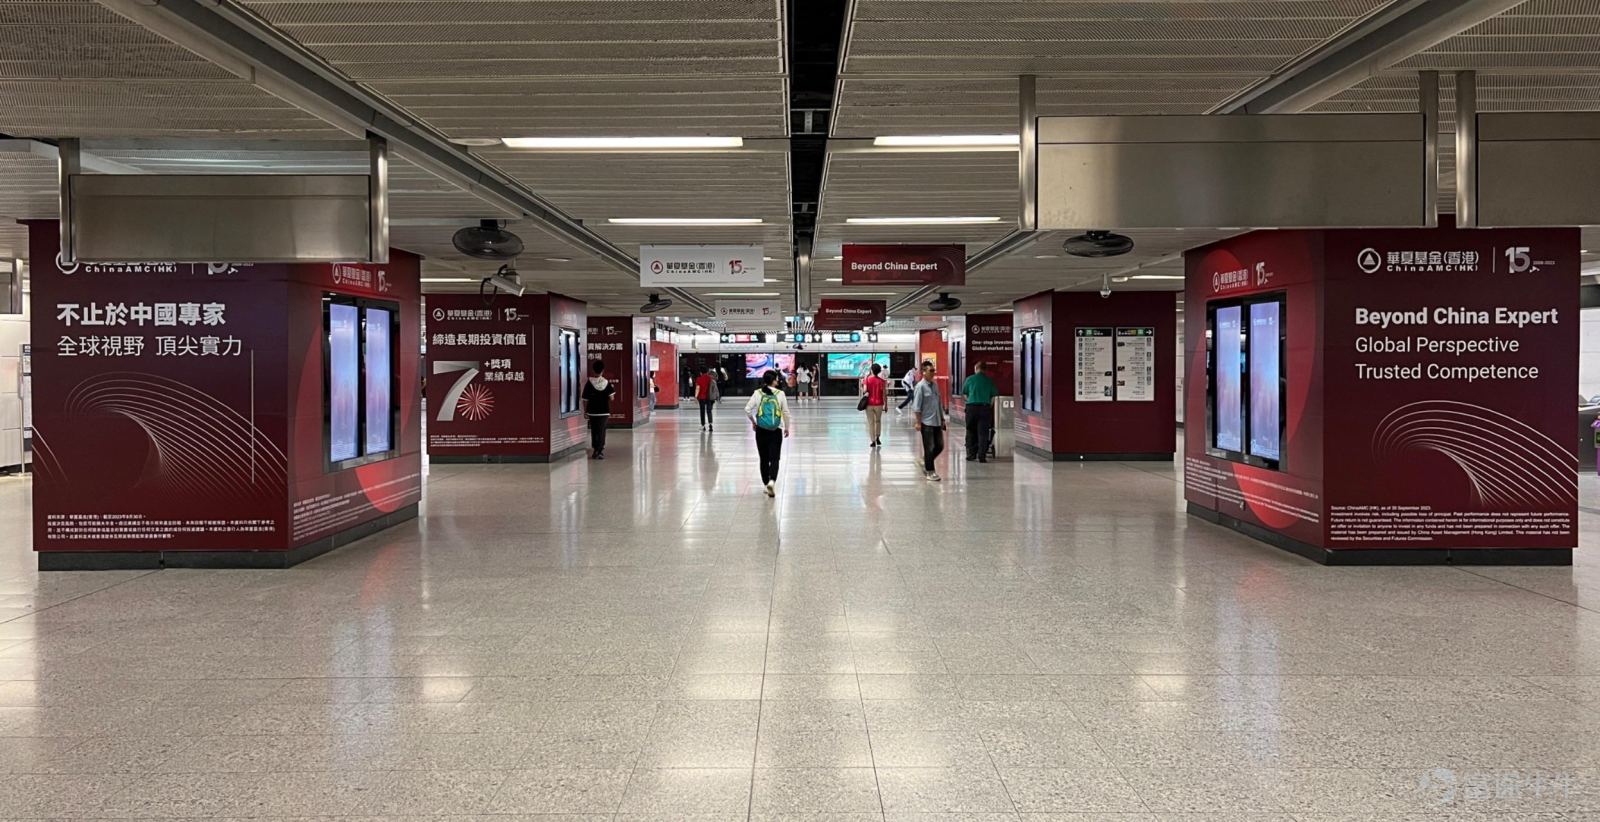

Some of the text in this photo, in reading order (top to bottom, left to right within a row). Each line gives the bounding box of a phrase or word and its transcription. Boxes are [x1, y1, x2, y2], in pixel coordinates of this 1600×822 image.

[728, 260, 742, 274] 15
[851, 262, 938, 272] Beyond China Expert
[1387, 251, 1479, 266] 華夏基金(香港)
[1505, 247, 1530, 273] 15
[57, 302, 226, 326] 不止於中國專家
[504, 308, 517, 321] 15
[1356, 307, 1558, 329] Beyond China Expert
[57, 335, 242, 357] 全球視野 頂尖實力
[433, 334, 527, 345] 締造長期投資價值
[1356, 337, 1520, 356] Global Perspective
[1356, 363, 1539, 383] Trusted Competence
[433, 361, 481, 420] 7
